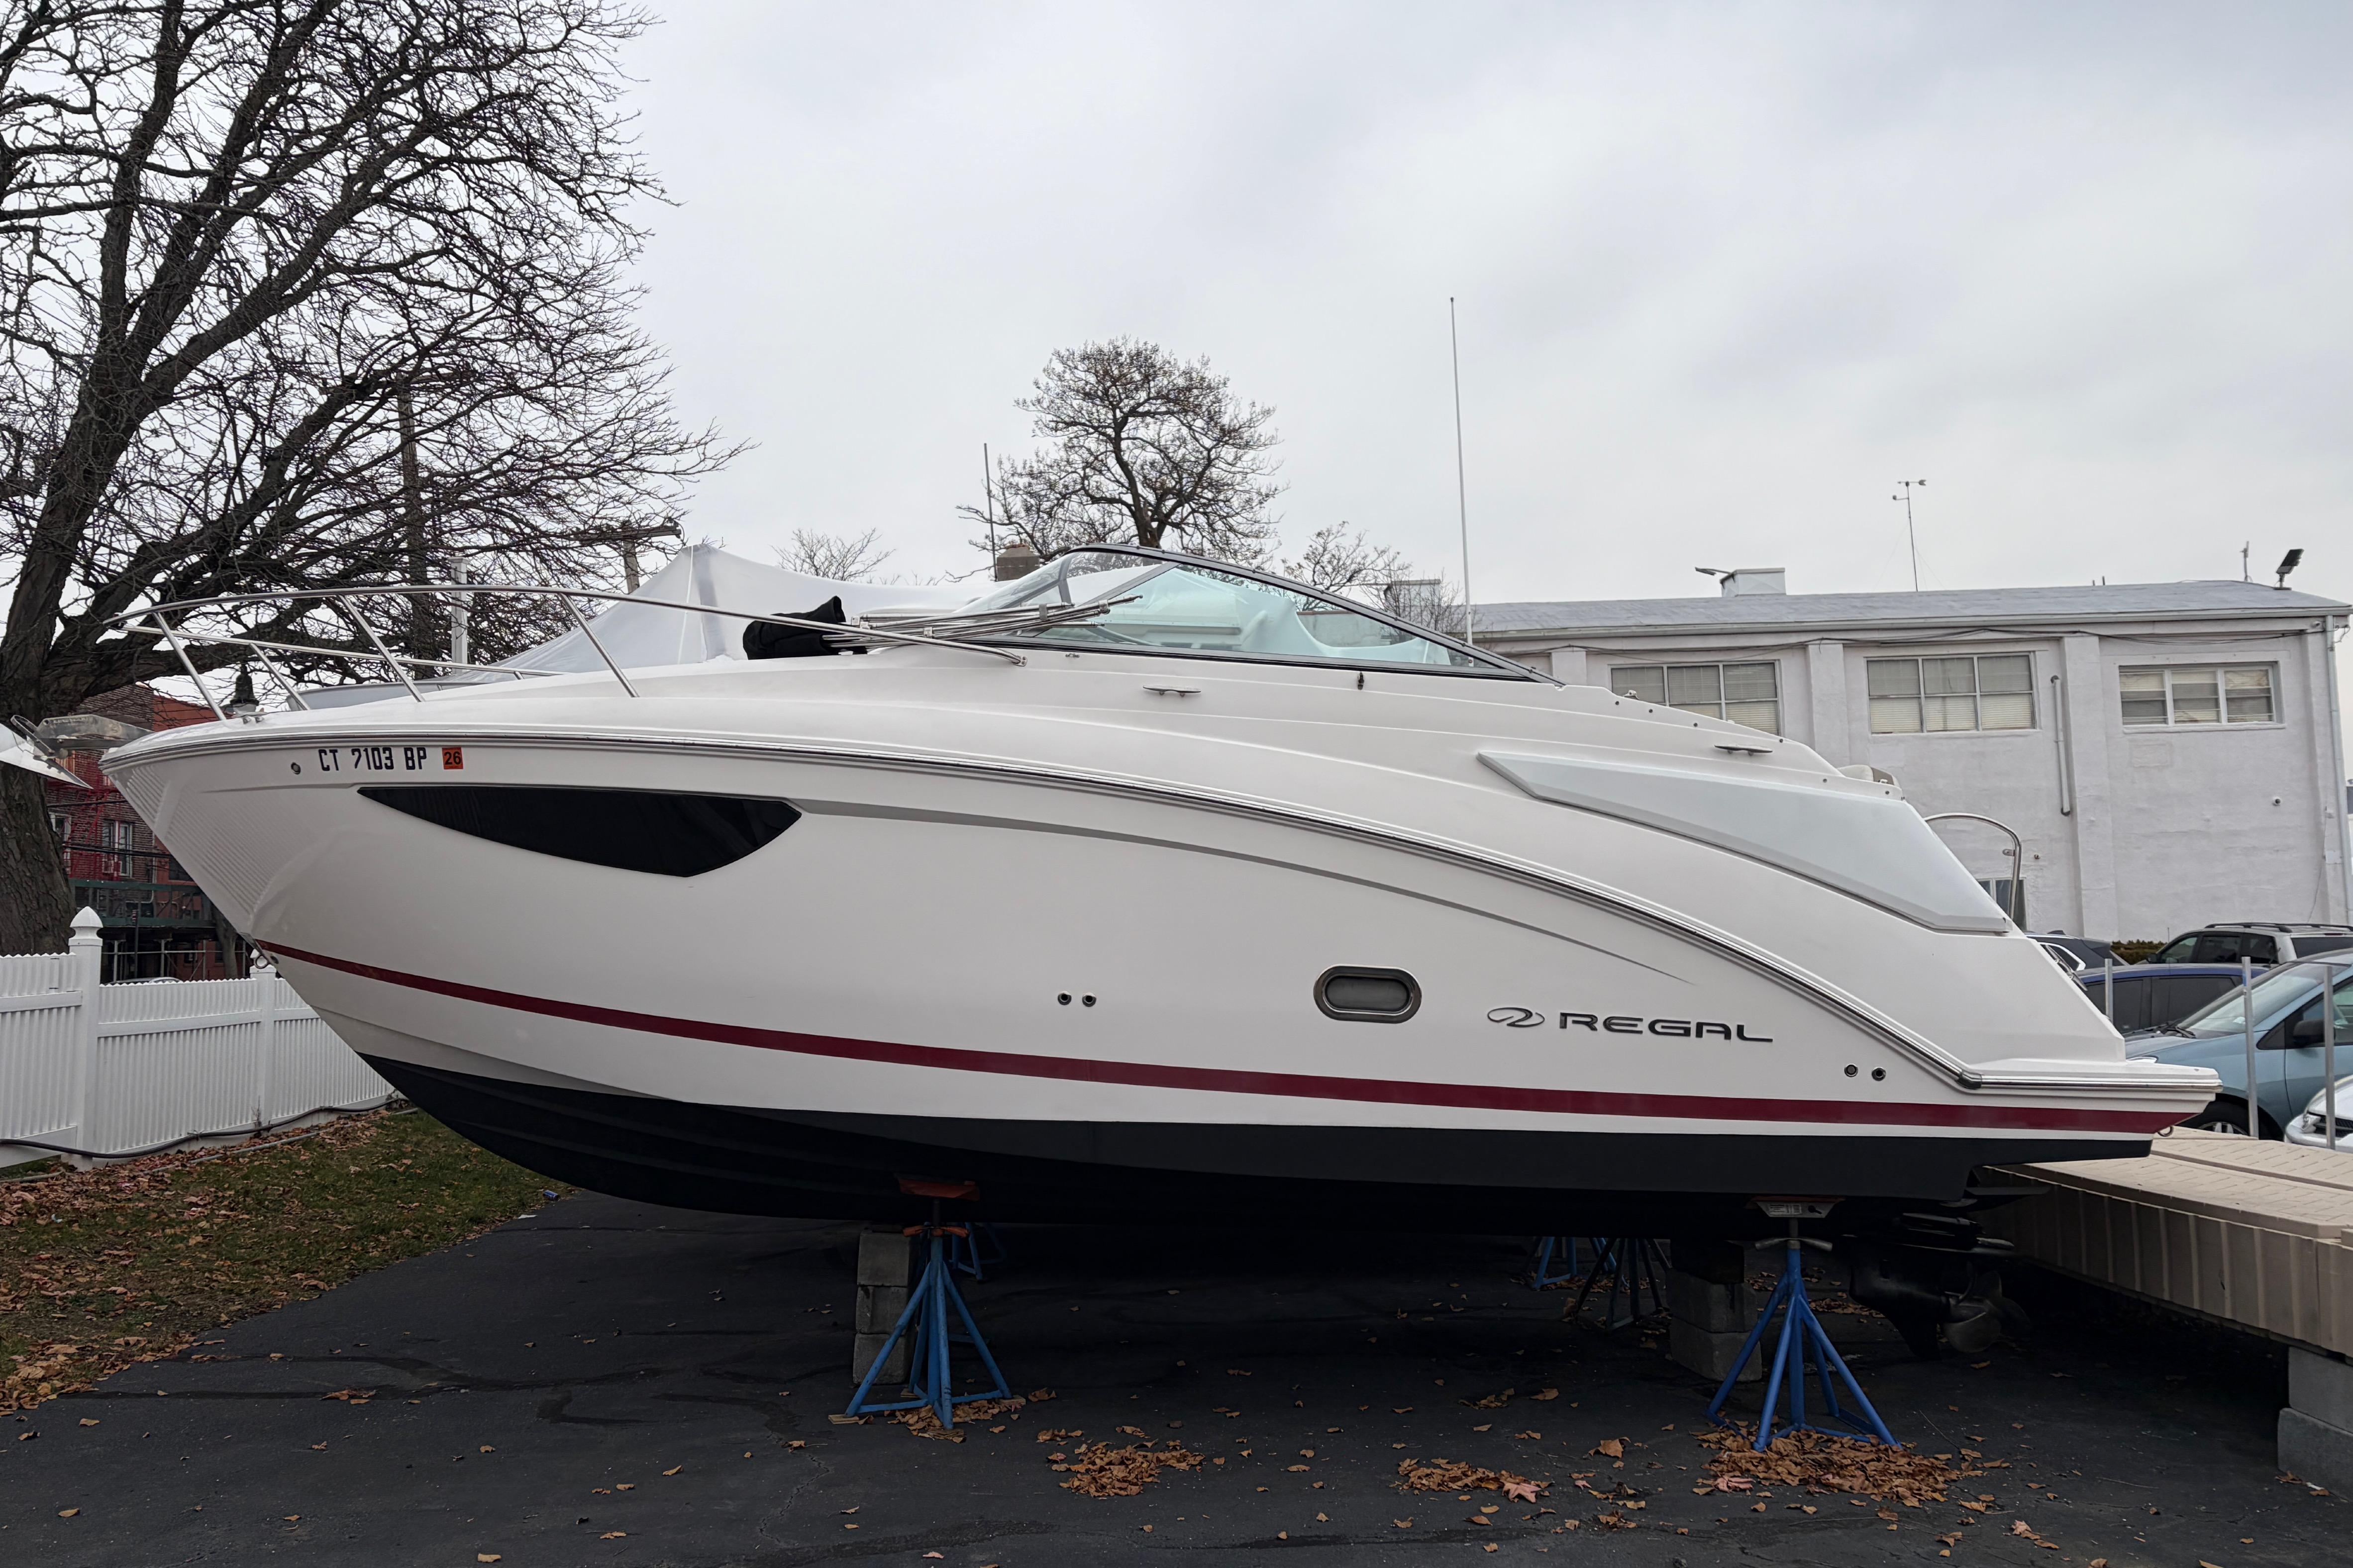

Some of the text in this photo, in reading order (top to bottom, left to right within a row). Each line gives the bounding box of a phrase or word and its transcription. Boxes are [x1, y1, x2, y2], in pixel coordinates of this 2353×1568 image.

[318, 747, 427, 771] CT 7103 BP
[444, 751, 461, 765] 26
[1559, 1012, 1773, 1043] REGAL
